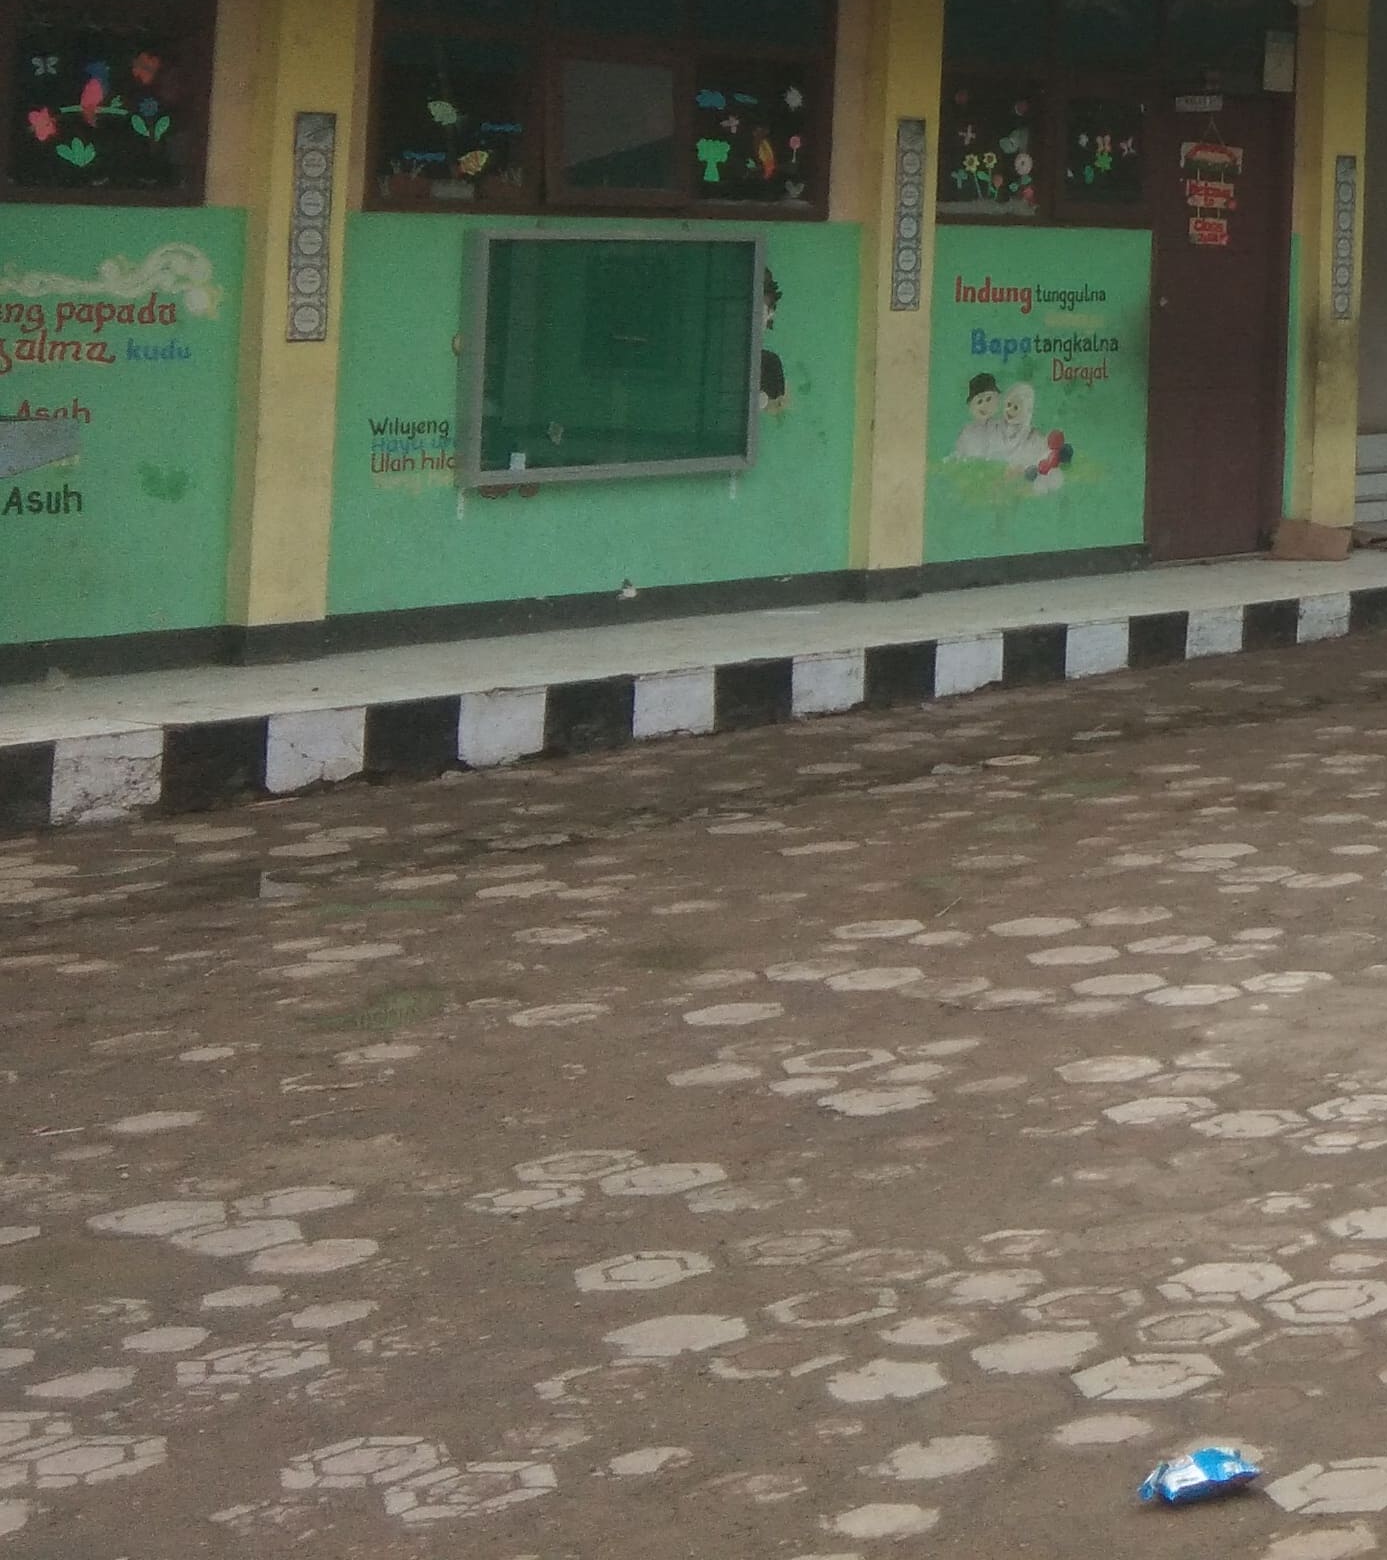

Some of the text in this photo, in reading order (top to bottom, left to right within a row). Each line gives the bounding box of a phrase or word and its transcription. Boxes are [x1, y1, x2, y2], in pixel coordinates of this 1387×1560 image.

[955, 275, 1106, 314] Indung tunggulna
[0, 291, 177, 333] ng papada
[126, 338, 192, 361] kudu
[972, 328, 1119, 364] Bapa tangkalna
[368, 416, 449, 440] Wilujeng
[371, 451, 415, 473] Ulah
[2, 483, 83, 516] Asuh
